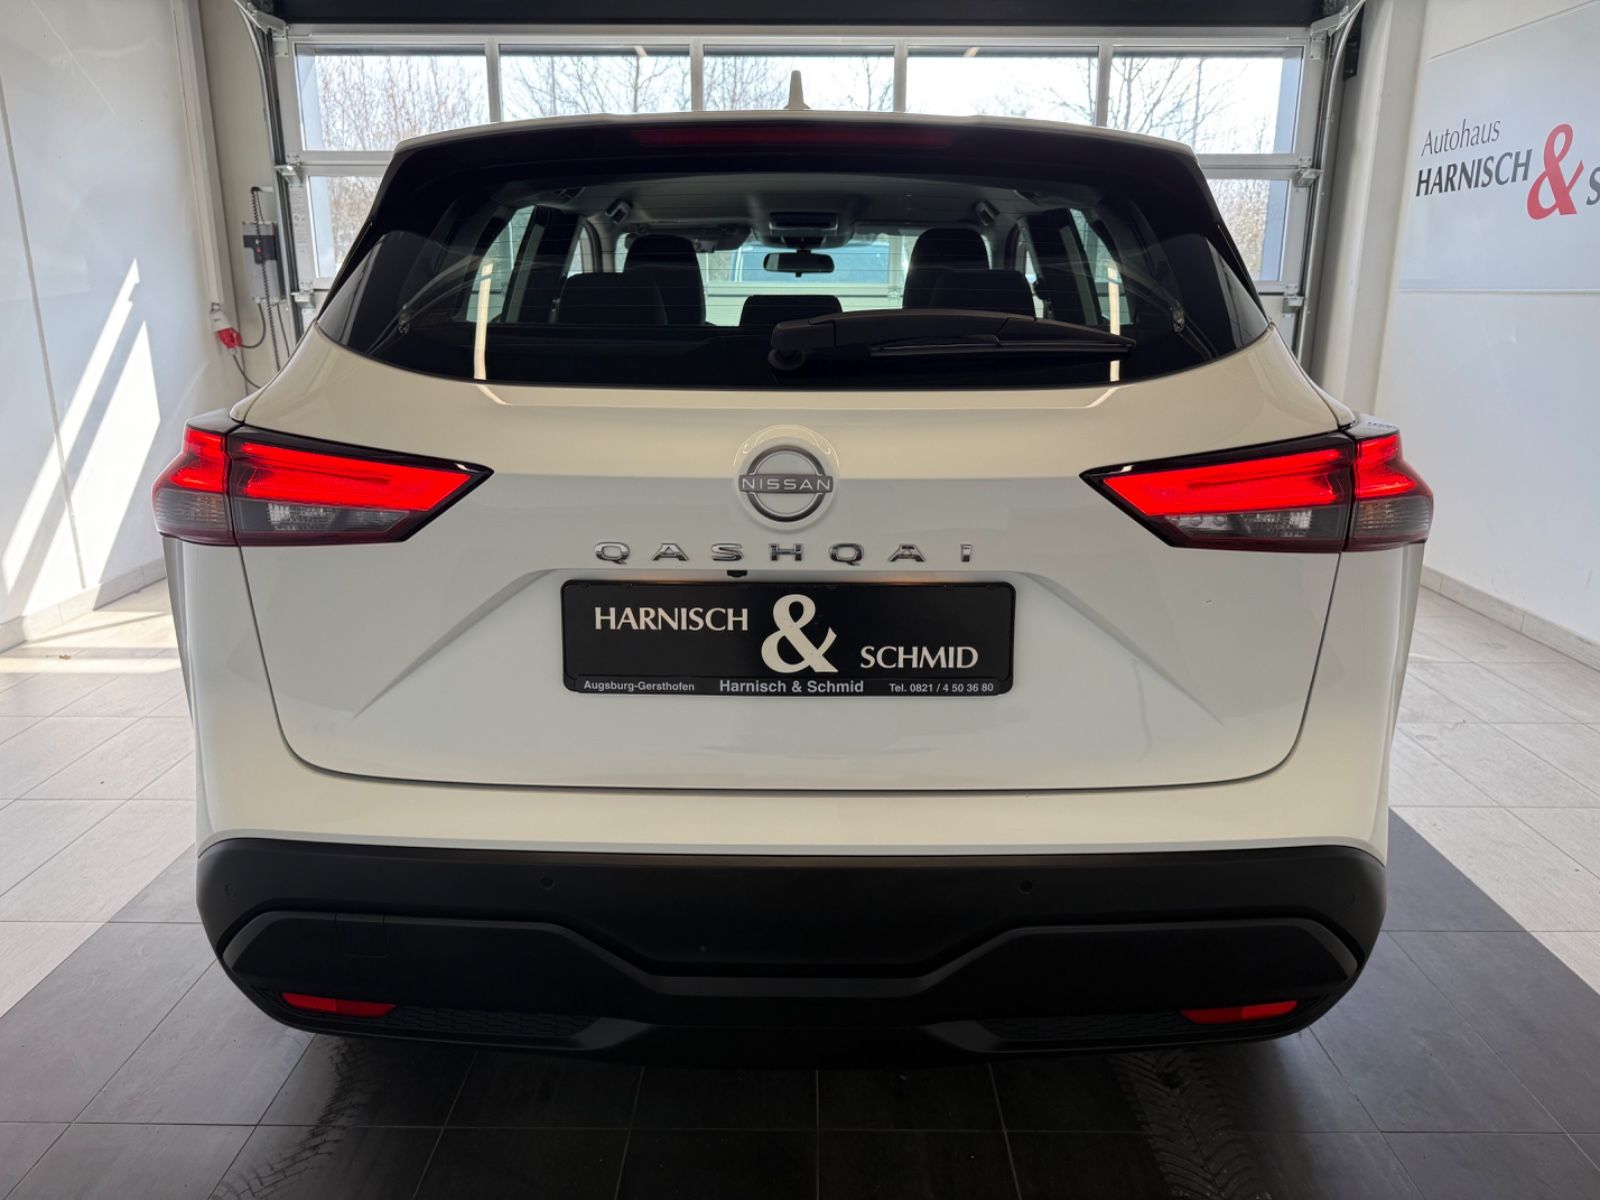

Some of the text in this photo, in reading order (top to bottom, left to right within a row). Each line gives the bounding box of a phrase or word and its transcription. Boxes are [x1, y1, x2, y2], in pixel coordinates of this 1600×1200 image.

[1421, 118, 1501, 157] Autohaus
[1415, 148, 1533, 197] HARNISCH
[1526, 123, 1584, 220] &
[741, 477, 832, 491] NISSAN
[594, 541, 974, 566] QASHQAI
[594, 594, 979, 673] HARNISCH & SCHMID
[584, 680, 695, 692] Augsburg-Gersthofen
[719, 679, 864, 693] Harnisch & Schmid
[889, 683, 907, 692] Tel.
[909, 683, 933, 692] 0821
[942, 683, 949, 692] 4
[952, 683, 964, 692] 50
[966, 683, 979, 692] 36
[981, 683, 994, 692] 80
